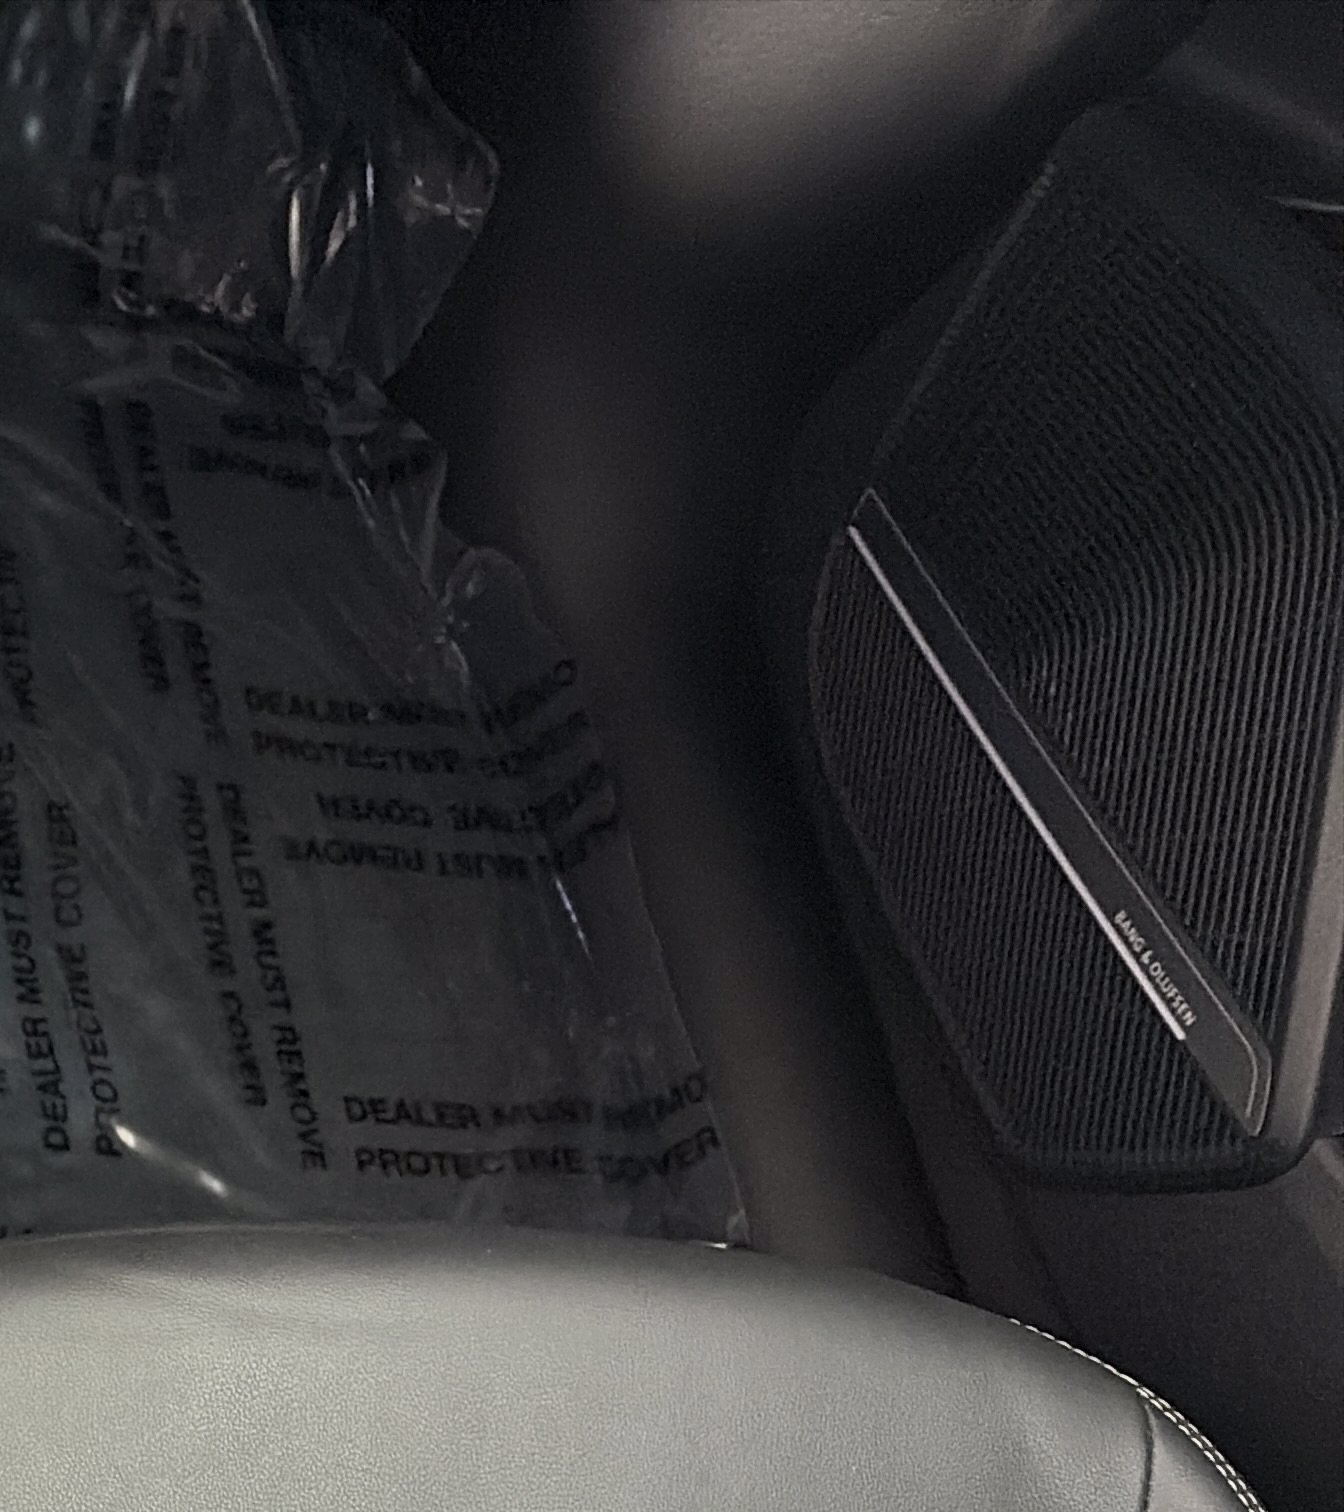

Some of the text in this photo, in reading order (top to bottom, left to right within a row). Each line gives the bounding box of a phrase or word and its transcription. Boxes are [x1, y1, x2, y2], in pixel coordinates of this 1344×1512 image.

[43, 799, 85, 930] COVER
[1, 905, 44, 1007] MUST
[19, 1014, 73, 1154] DEALER
[341, 1093, 482, 1131] DEALER
